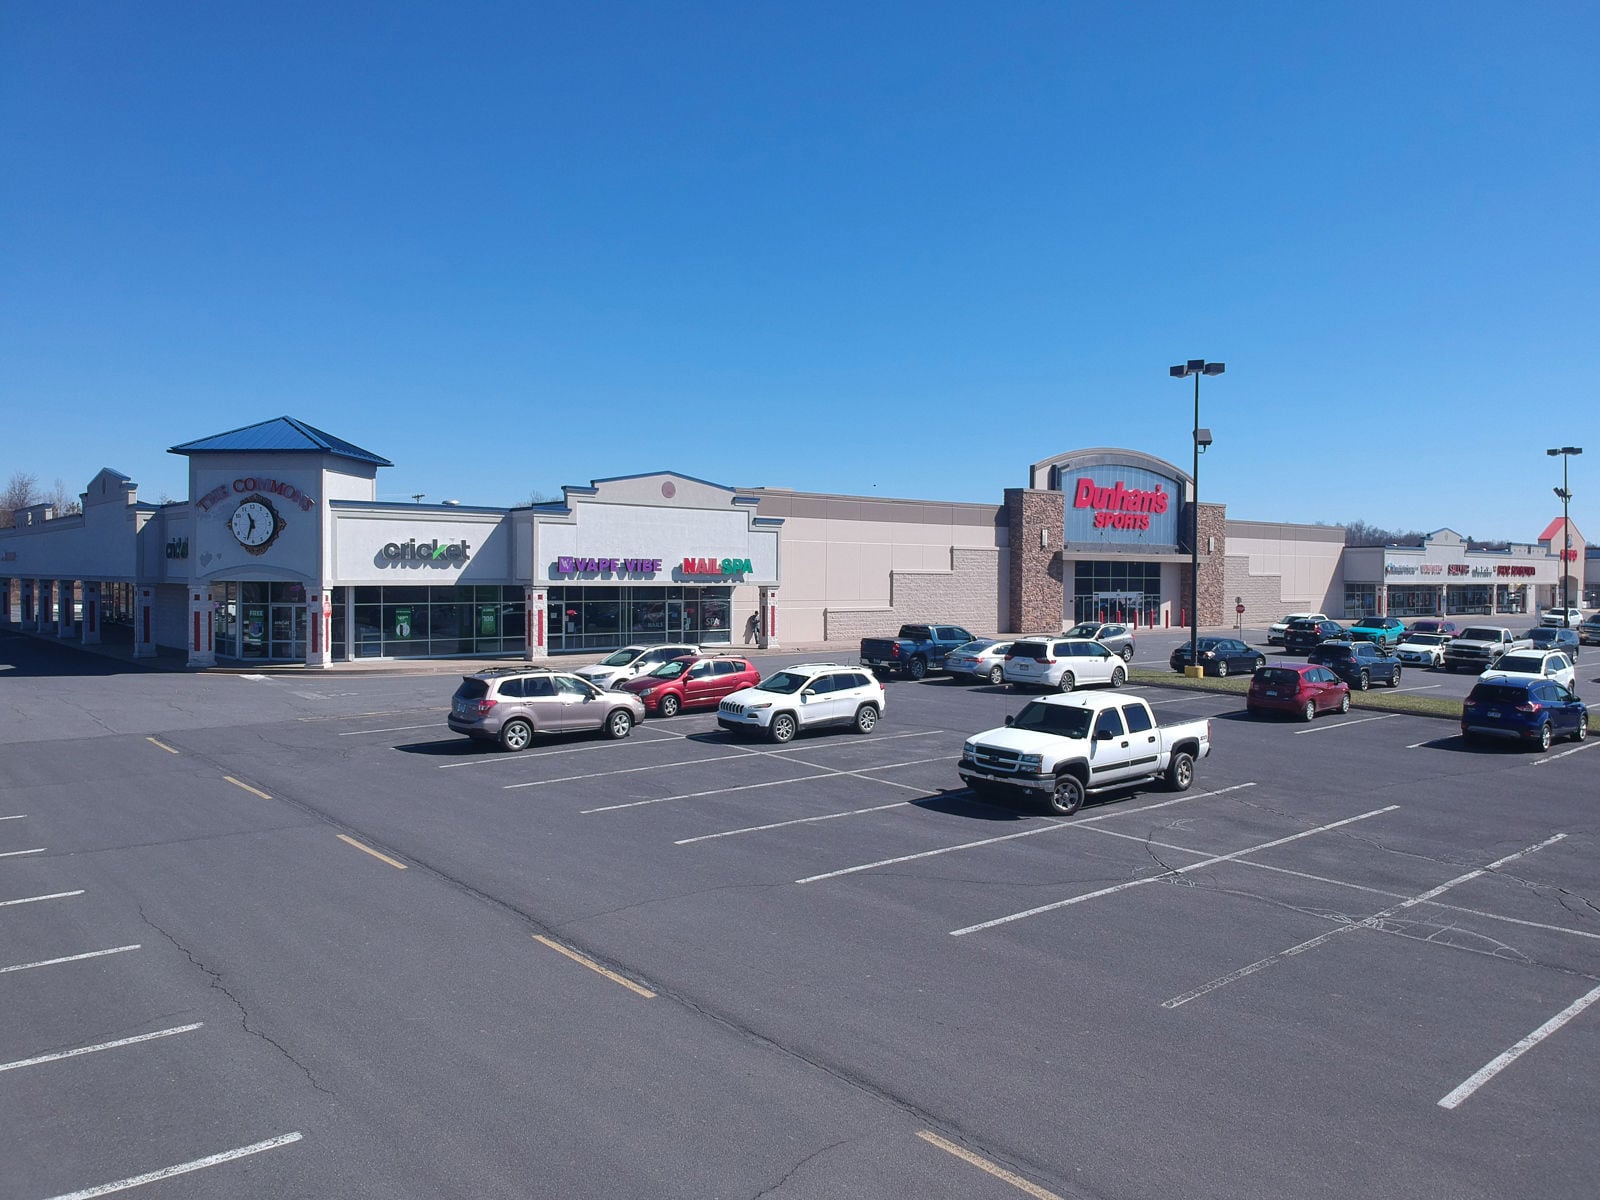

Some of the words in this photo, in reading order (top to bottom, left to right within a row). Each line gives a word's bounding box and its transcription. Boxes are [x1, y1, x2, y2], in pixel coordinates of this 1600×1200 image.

[196, 485, 231, 512] THE
[233, 477, 313, 512] COMMONS
[1074, 477, 1168, 514] Dunham's
[1094, 511, 1150, 531] SPORTS
[383, 538, 471, 561] cricket
[574, 558, 620, 572] VAPE
[624, 558, 663, 573] VIBE
[705, 617, 720, 626] SPA
